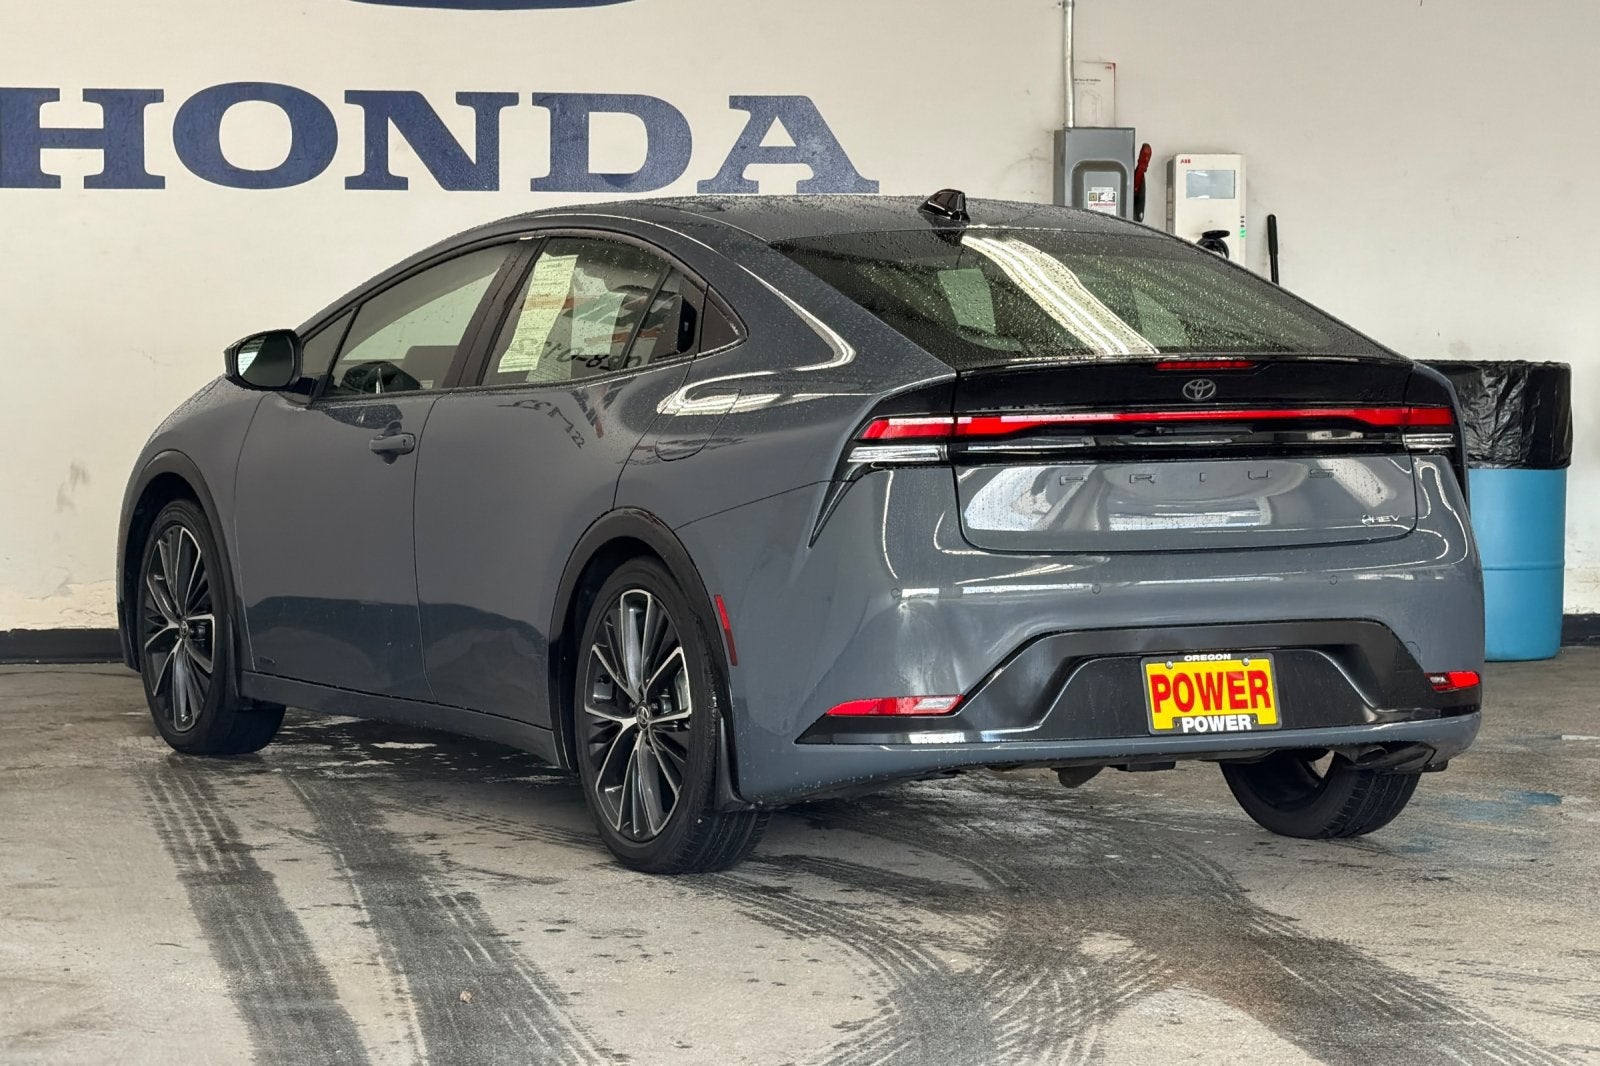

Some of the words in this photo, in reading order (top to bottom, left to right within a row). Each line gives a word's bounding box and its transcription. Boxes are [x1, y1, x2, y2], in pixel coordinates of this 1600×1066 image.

[0, 82, 880, 194] HONDA
[1060, 468, 1334, 486] PRIUS
[1184, 653, 1231, 662] OREGON
[1150, 670, 1271, 713] POWER
[1181, 714, 1252, 733] POWER
